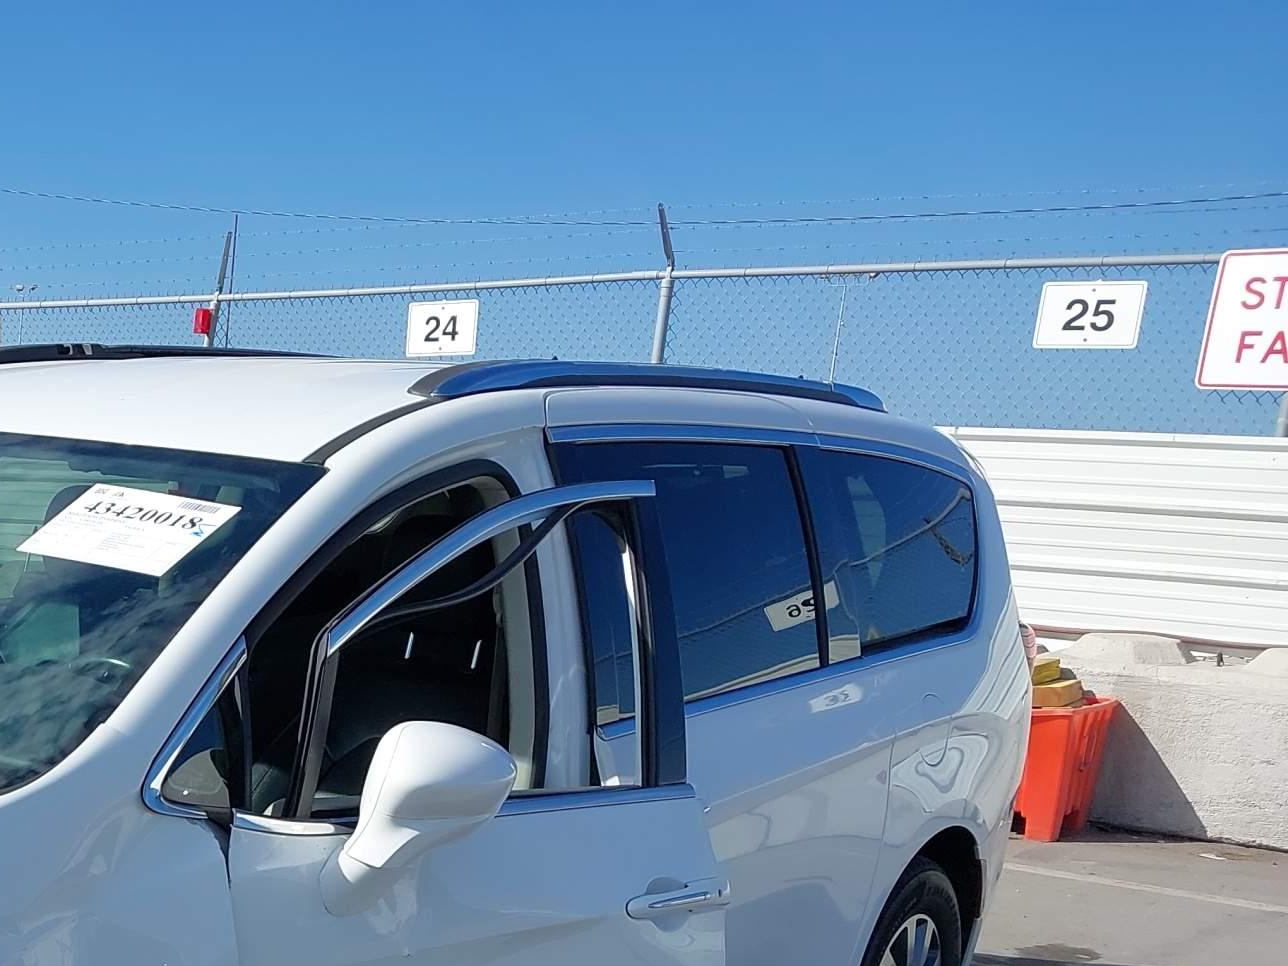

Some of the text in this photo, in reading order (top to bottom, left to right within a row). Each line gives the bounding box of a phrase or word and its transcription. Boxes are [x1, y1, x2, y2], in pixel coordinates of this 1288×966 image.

[424, 314, 459, 342] 24
[1061, 298, 1117, 332] 25
[1234, 330, 1288, 364] FA
[84, 499, 204, 530] 43420018
